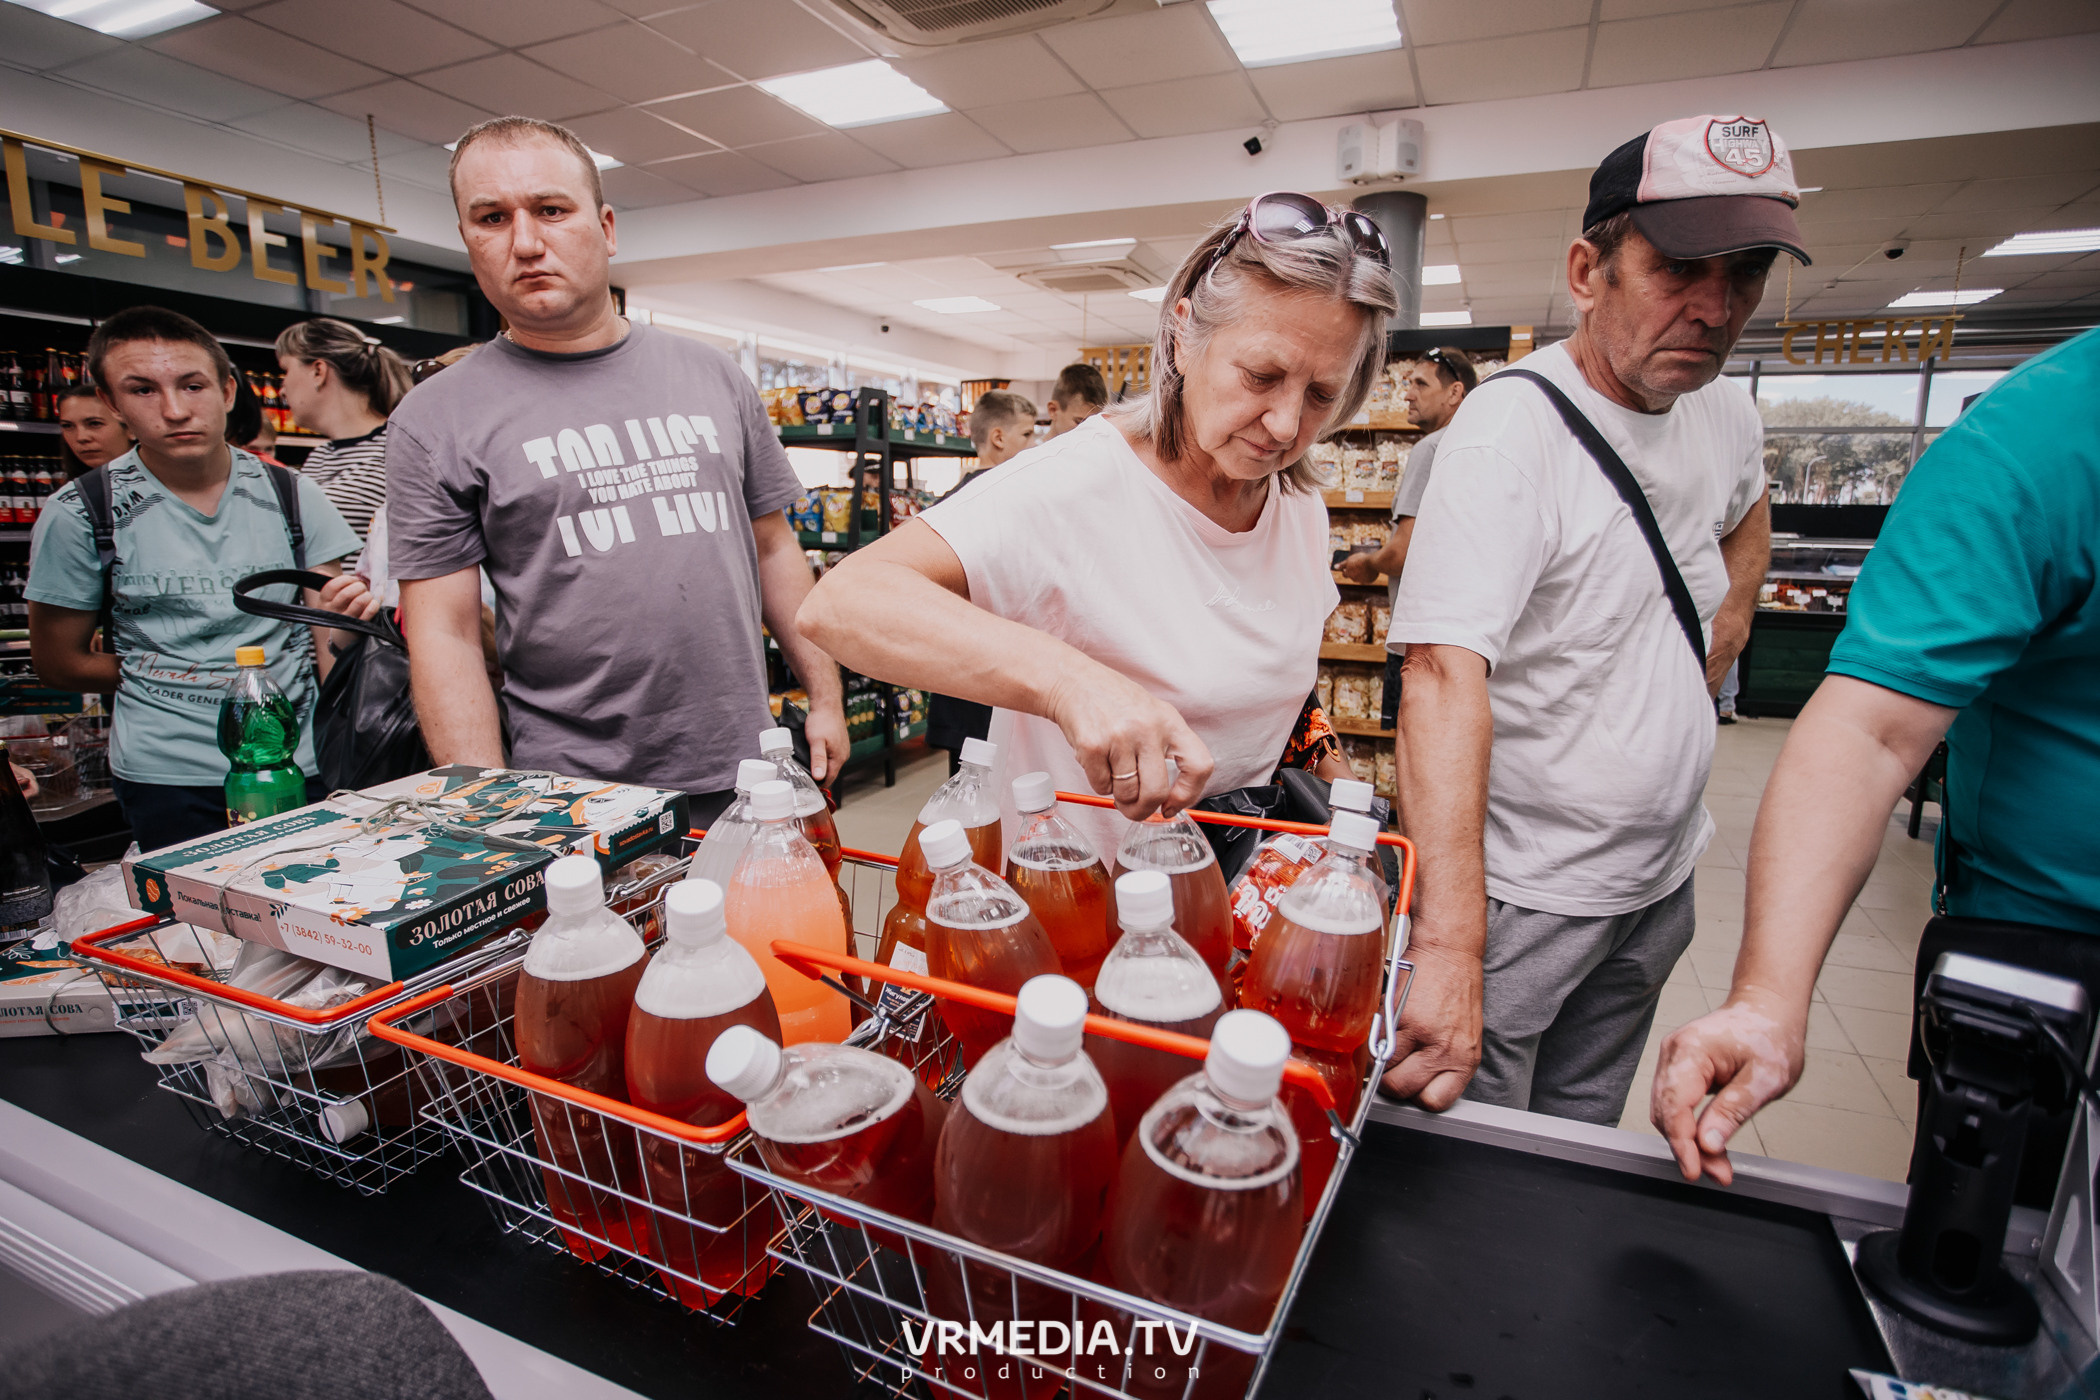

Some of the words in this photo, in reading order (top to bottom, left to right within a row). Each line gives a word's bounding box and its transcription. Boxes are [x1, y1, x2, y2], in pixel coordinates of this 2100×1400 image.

[1722, 126, 1759, 138] SURF
[1724, 148, 1764, 167] 45
[3, 138, 146, 259] LE
[183, 180, 396, 303] BEER
[1782, 320, 1955, 366] СНЕКИ
[577, 473, 588, 489] I
[586, 468, 622, 488] LOVE
[619, 463, 649, 483] THE
[646, 456, 699, 477] THINGS
[587, 486, 618, 504] YOU
[616, 478, 654, 500] HATE
[652, 472, 698, 492] ABOUT
[145, 686, 183, 701] EADER
[182, 828, 269, 858] ЗОЛОТАЯ
[272, 816, 318, 832] СОВА
[177, 891, 220, 911] Локальная
[223, 906, 262, 923] оставка!
[408, 891, 498, 946] ЗОЛОТАЯ
[503, 870, 546, 901] СОВА
[432, 930, 463, 949] Только
[463, 914, 497, 935] местное
[503, 897, 531, 915] свежее
[280, 922, 290, 933] +7
[291, 924, 324, 945] (3842)
[324, 934, 373, 957] 59-32-00
[49, 1003, 84, 1015] СОВА
